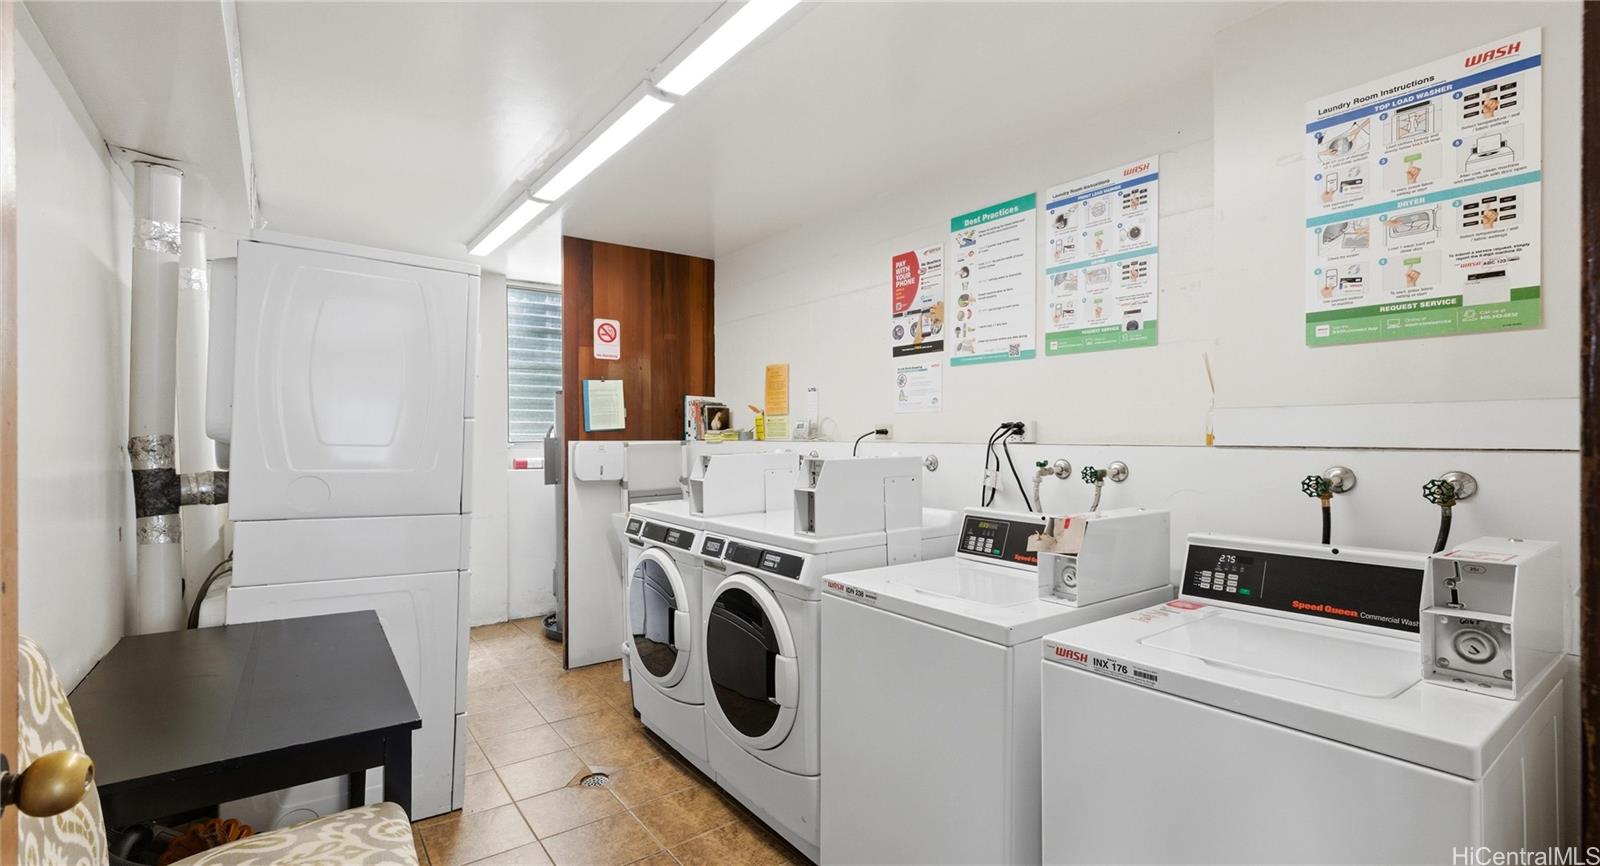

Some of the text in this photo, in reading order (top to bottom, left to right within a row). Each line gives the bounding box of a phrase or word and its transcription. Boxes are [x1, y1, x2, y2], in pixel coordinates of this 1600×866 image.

[1464, 41, 1520, 68] WASH
[1318, 74, 1434, 116] Laundry Room Instructions
[1374, 83, 1452, 112] TOP LOAD WASHER
[1122, 161, 1150, 177] WASH
[1396, 196, 1425, 208] DRYER
[964, 204, 1018, 227] Best Practices
[895, 260, 906, 268] PAY
[895, 265, 910, 275] WITH
[895, 271, 911, 281] YOUR
[895, 277, 915, 287] PHONE
[1379, 297, 1456, 312] REQUEST SERVICE
[1292, 600, 1324, 613] Speed
[1325, 605, 1358, 617] Queen
[1360, 611, 1400, 625] Commercial
[1055, 647, 1089, 663] WASH
[1093, 657, 1128, 675] INX 176
